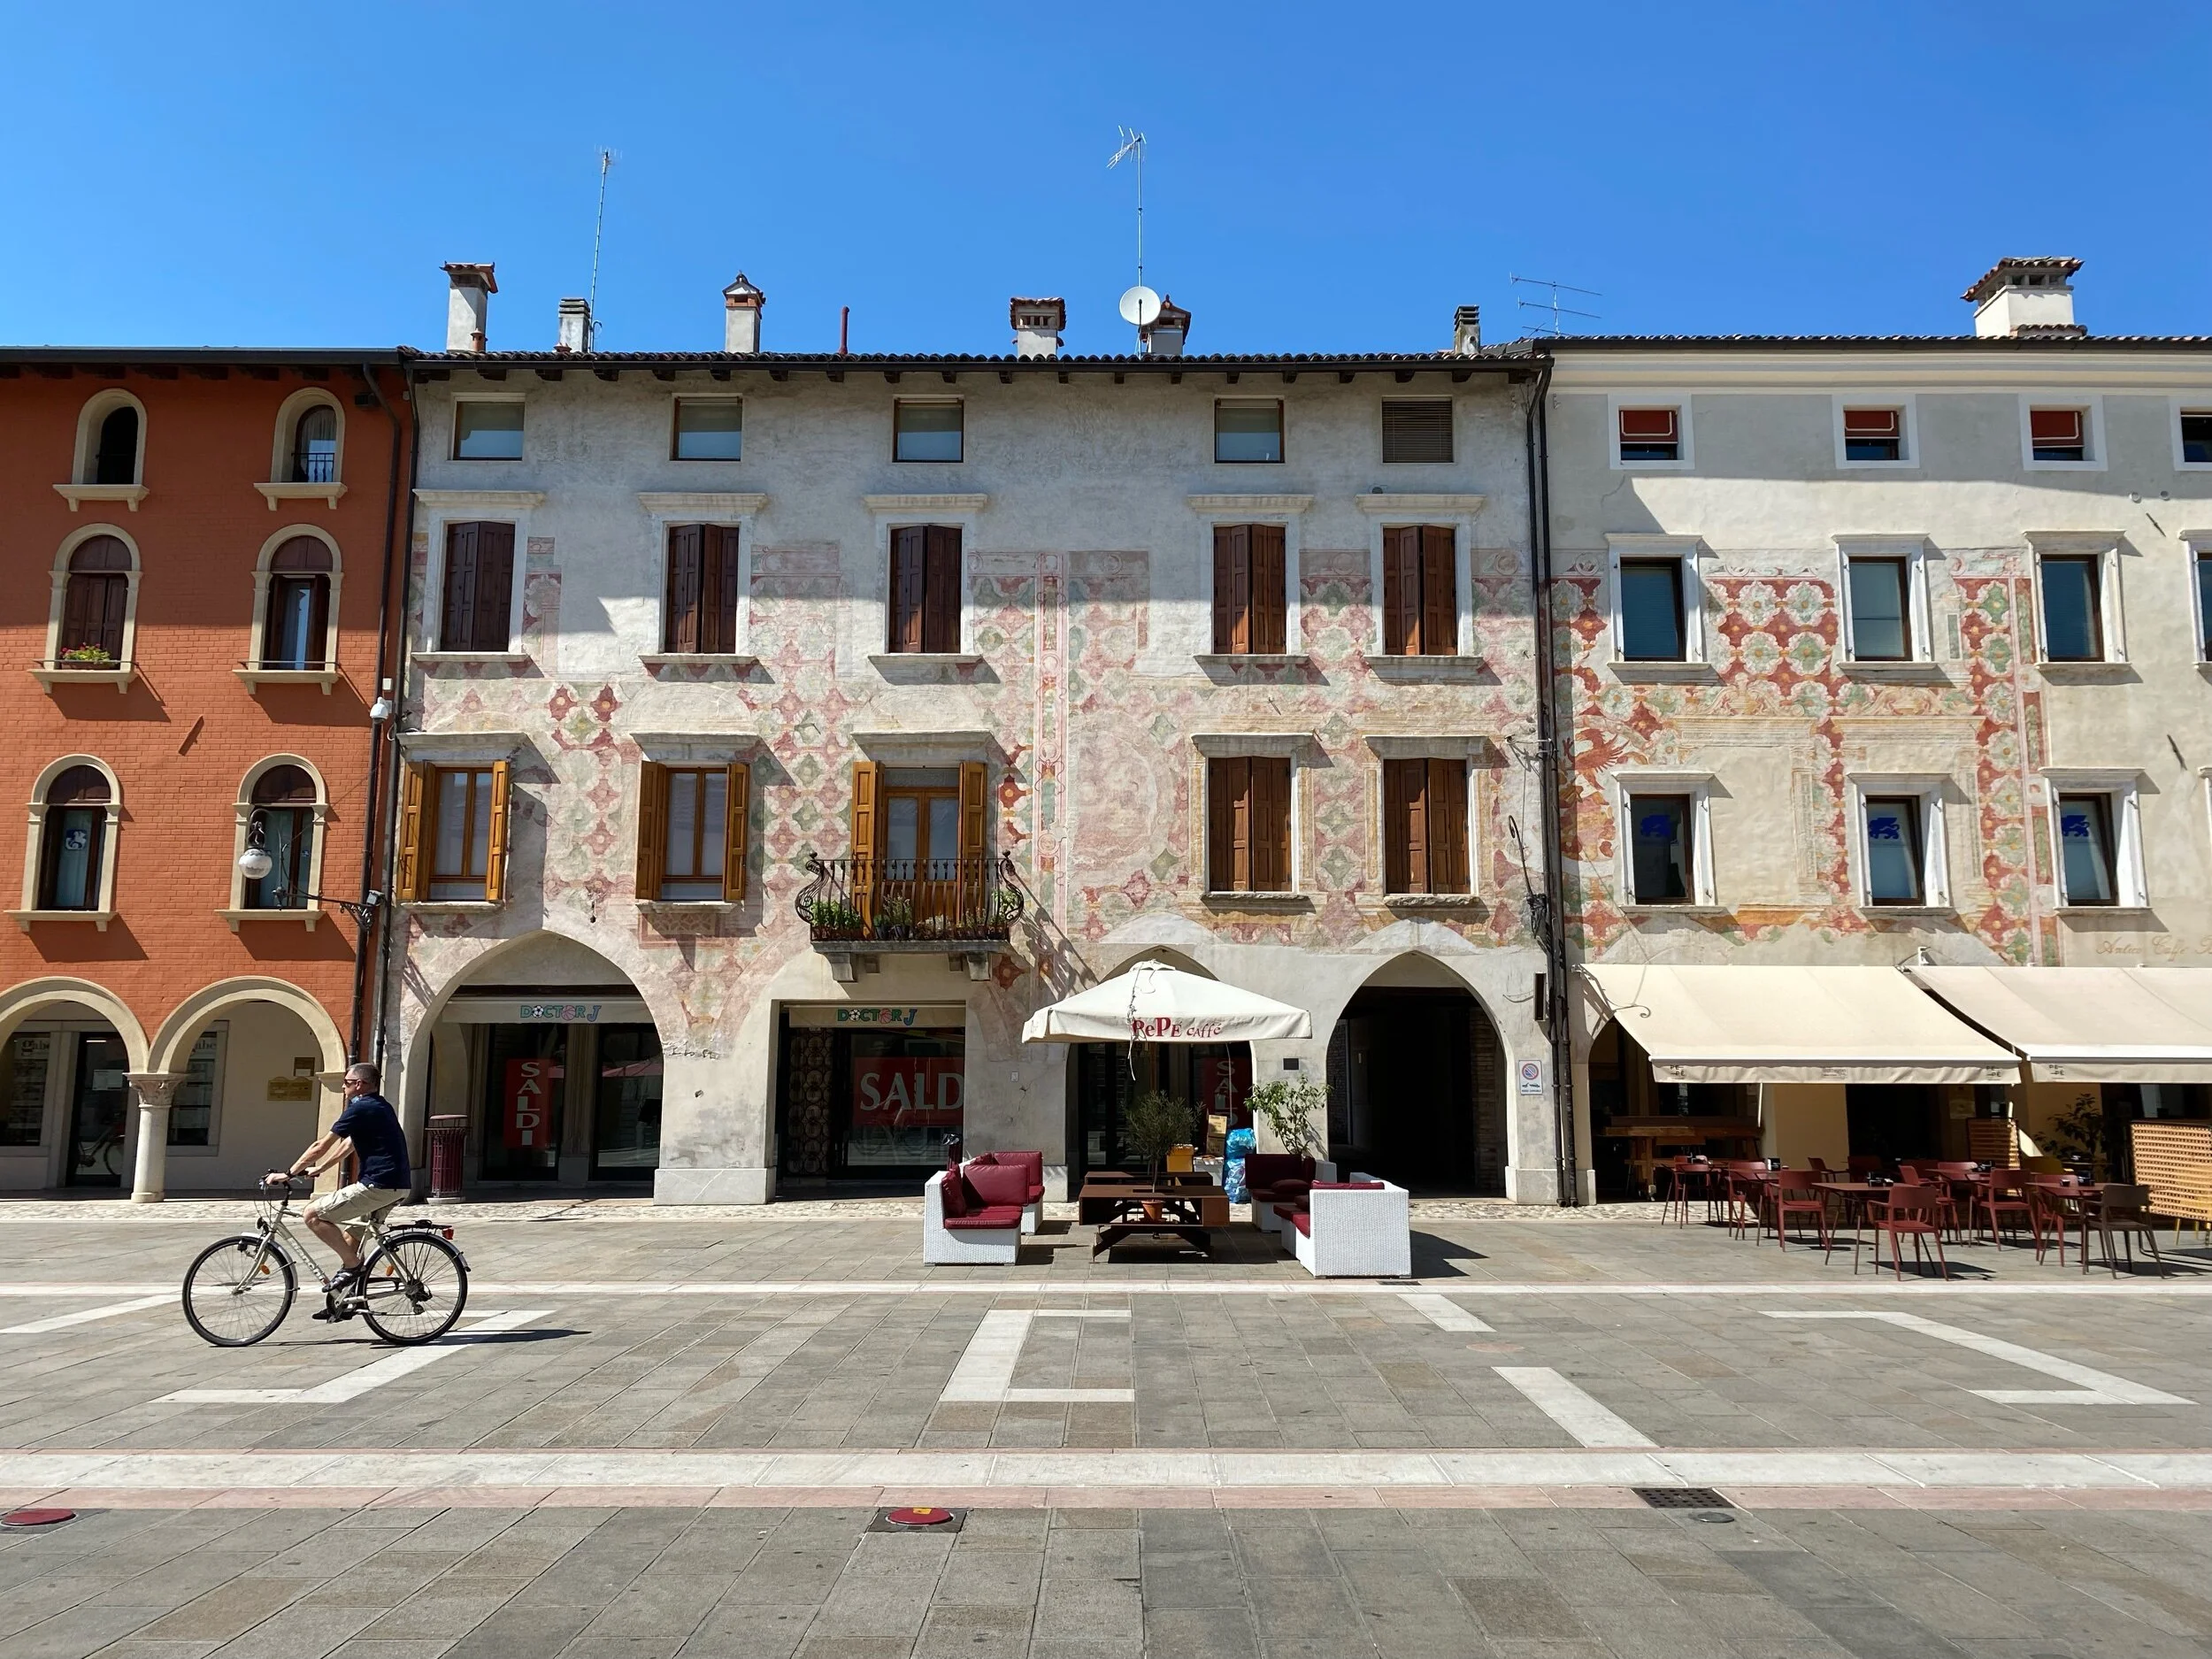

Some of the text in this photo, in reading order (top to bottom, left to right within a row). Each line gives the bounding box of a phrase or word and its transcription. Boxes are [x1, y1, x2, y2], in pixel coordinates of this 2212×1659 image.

[520, 1004, 602, 1022] DOCTOR J
[837, 1008, 918, 1025] DOCTOR J
[516, 1063, 542, 1146] SALDI
